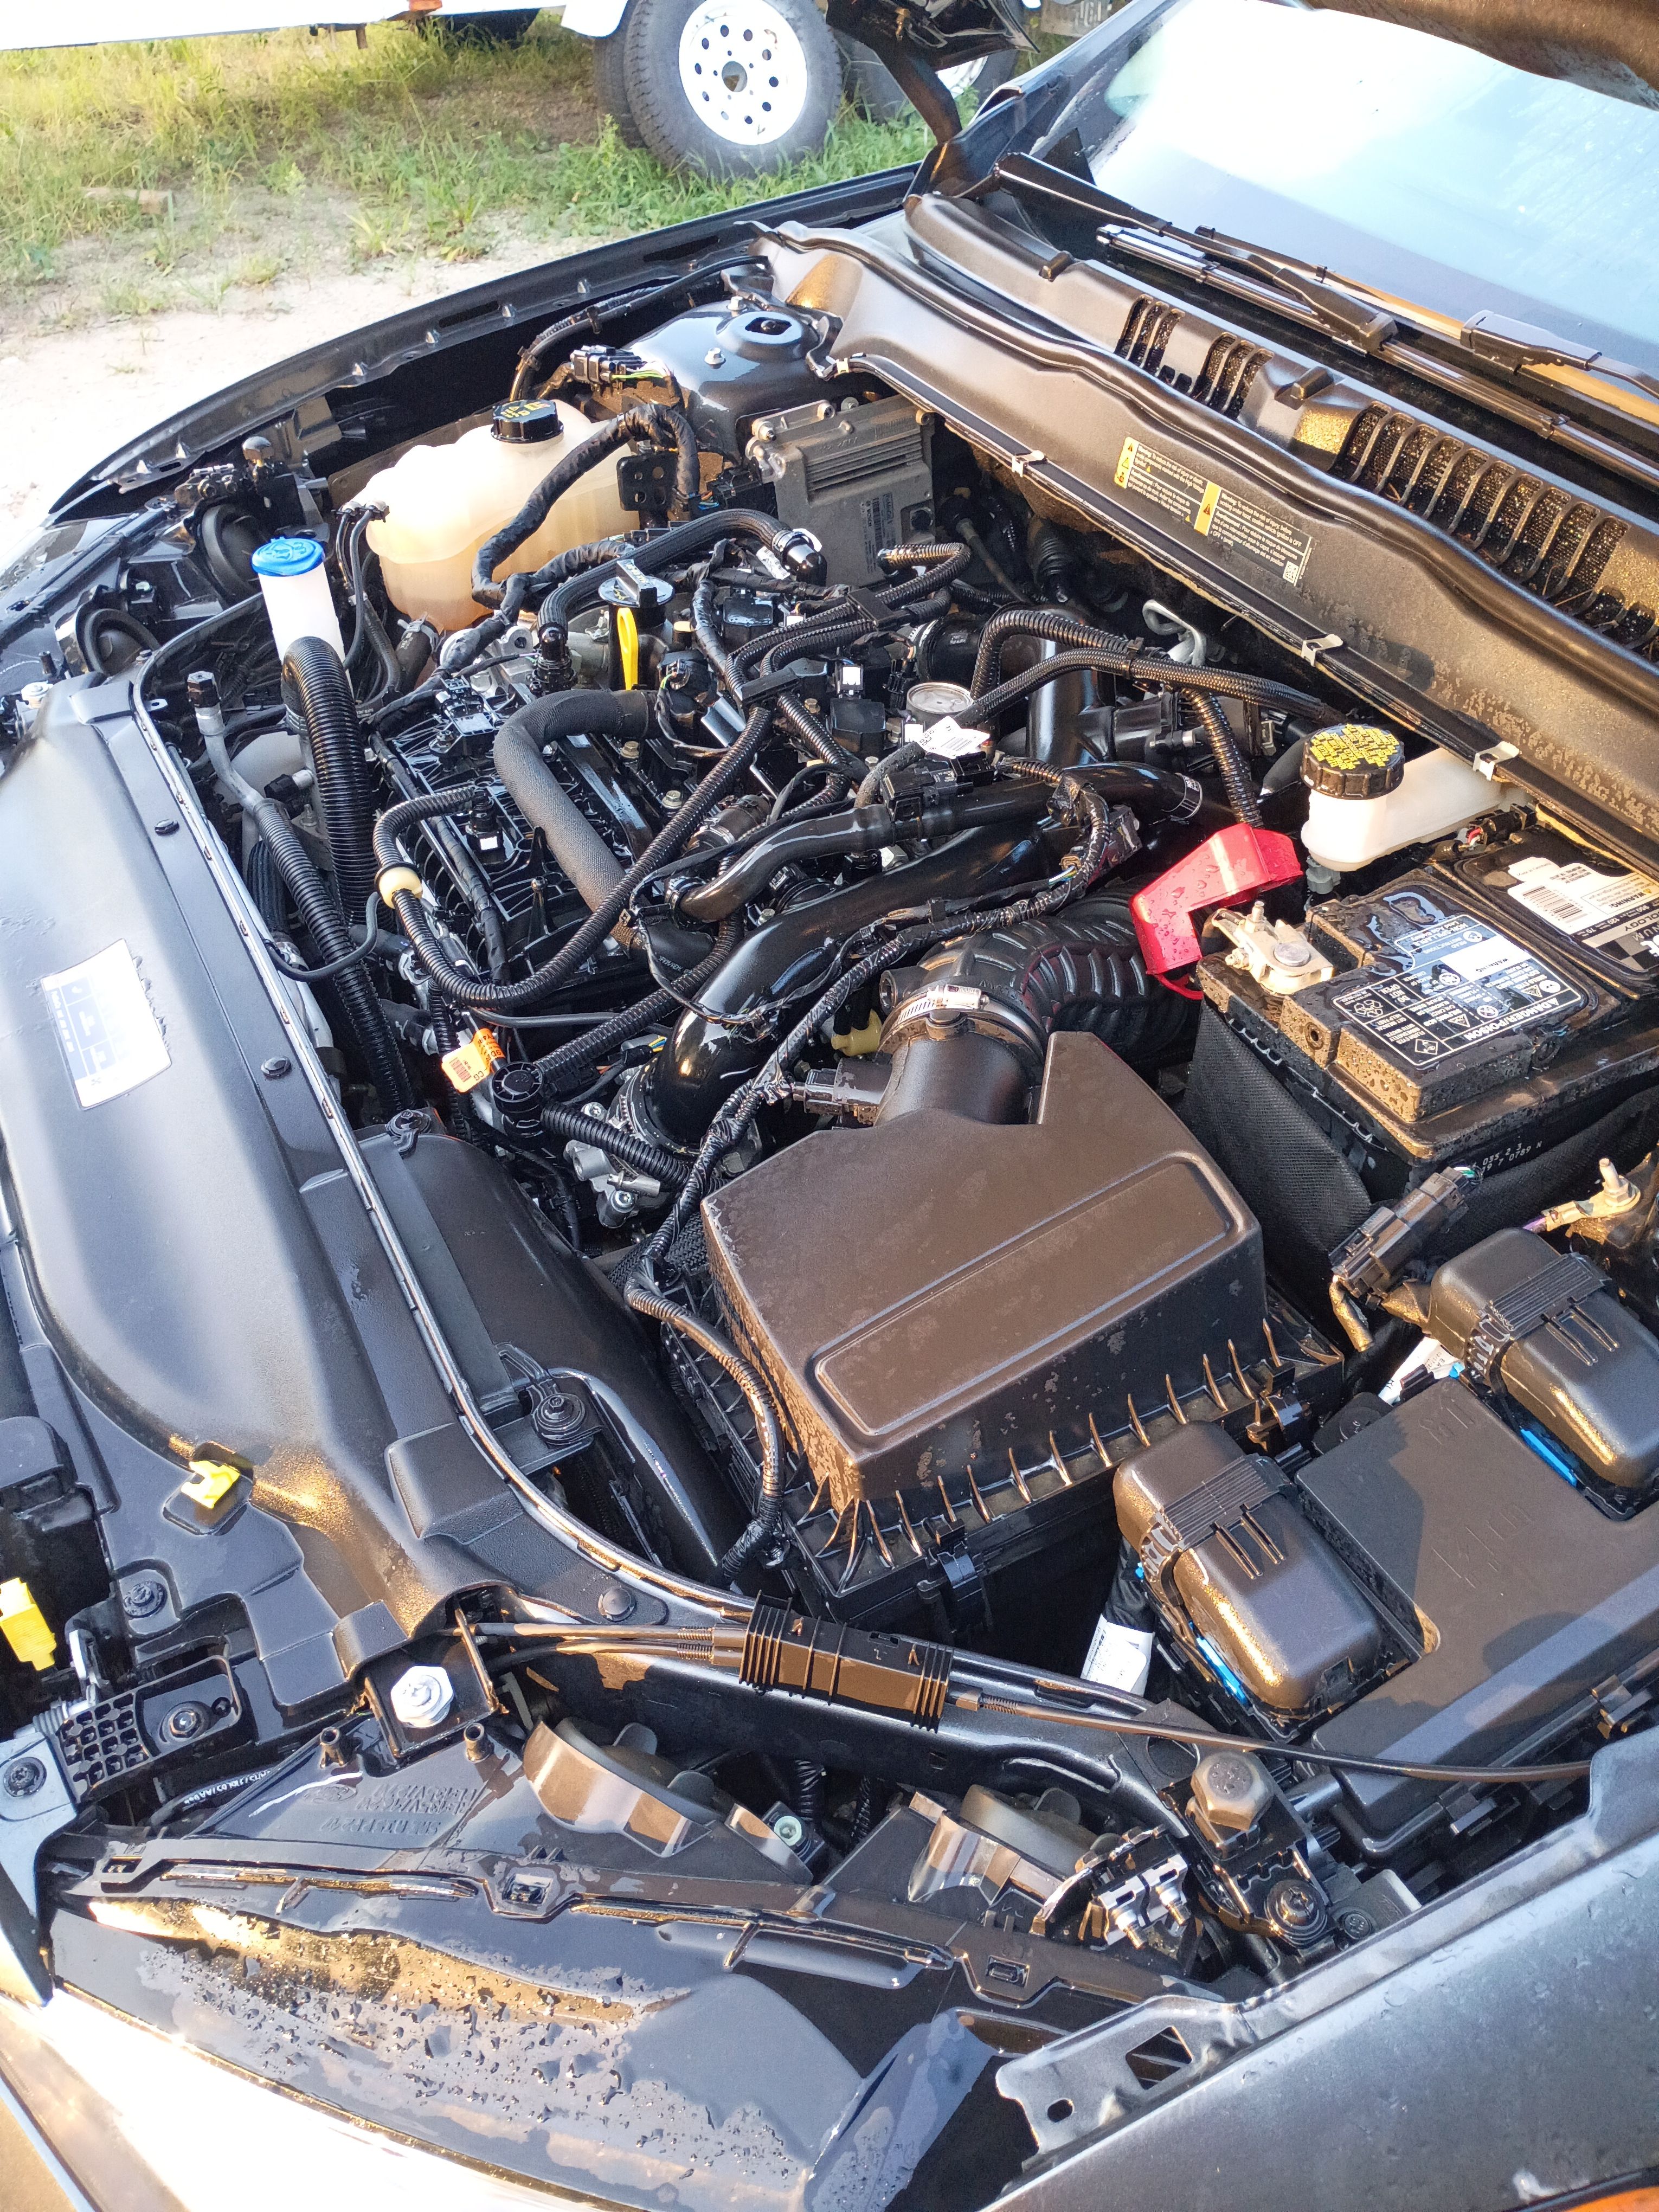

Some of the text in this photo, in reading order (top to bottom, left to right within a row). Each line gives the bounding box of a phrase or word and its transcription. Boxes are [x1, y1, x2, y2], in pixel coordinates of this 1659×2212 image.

[1610, 891, 1644, 909] WARNING:
[1625, 911, 1659, 931] OLOGY
[1377, 983, 1401, 995] OPEN.
[1387, 989, 1405, 999] NOT
[1395, 994, 1410, 1003] DO
